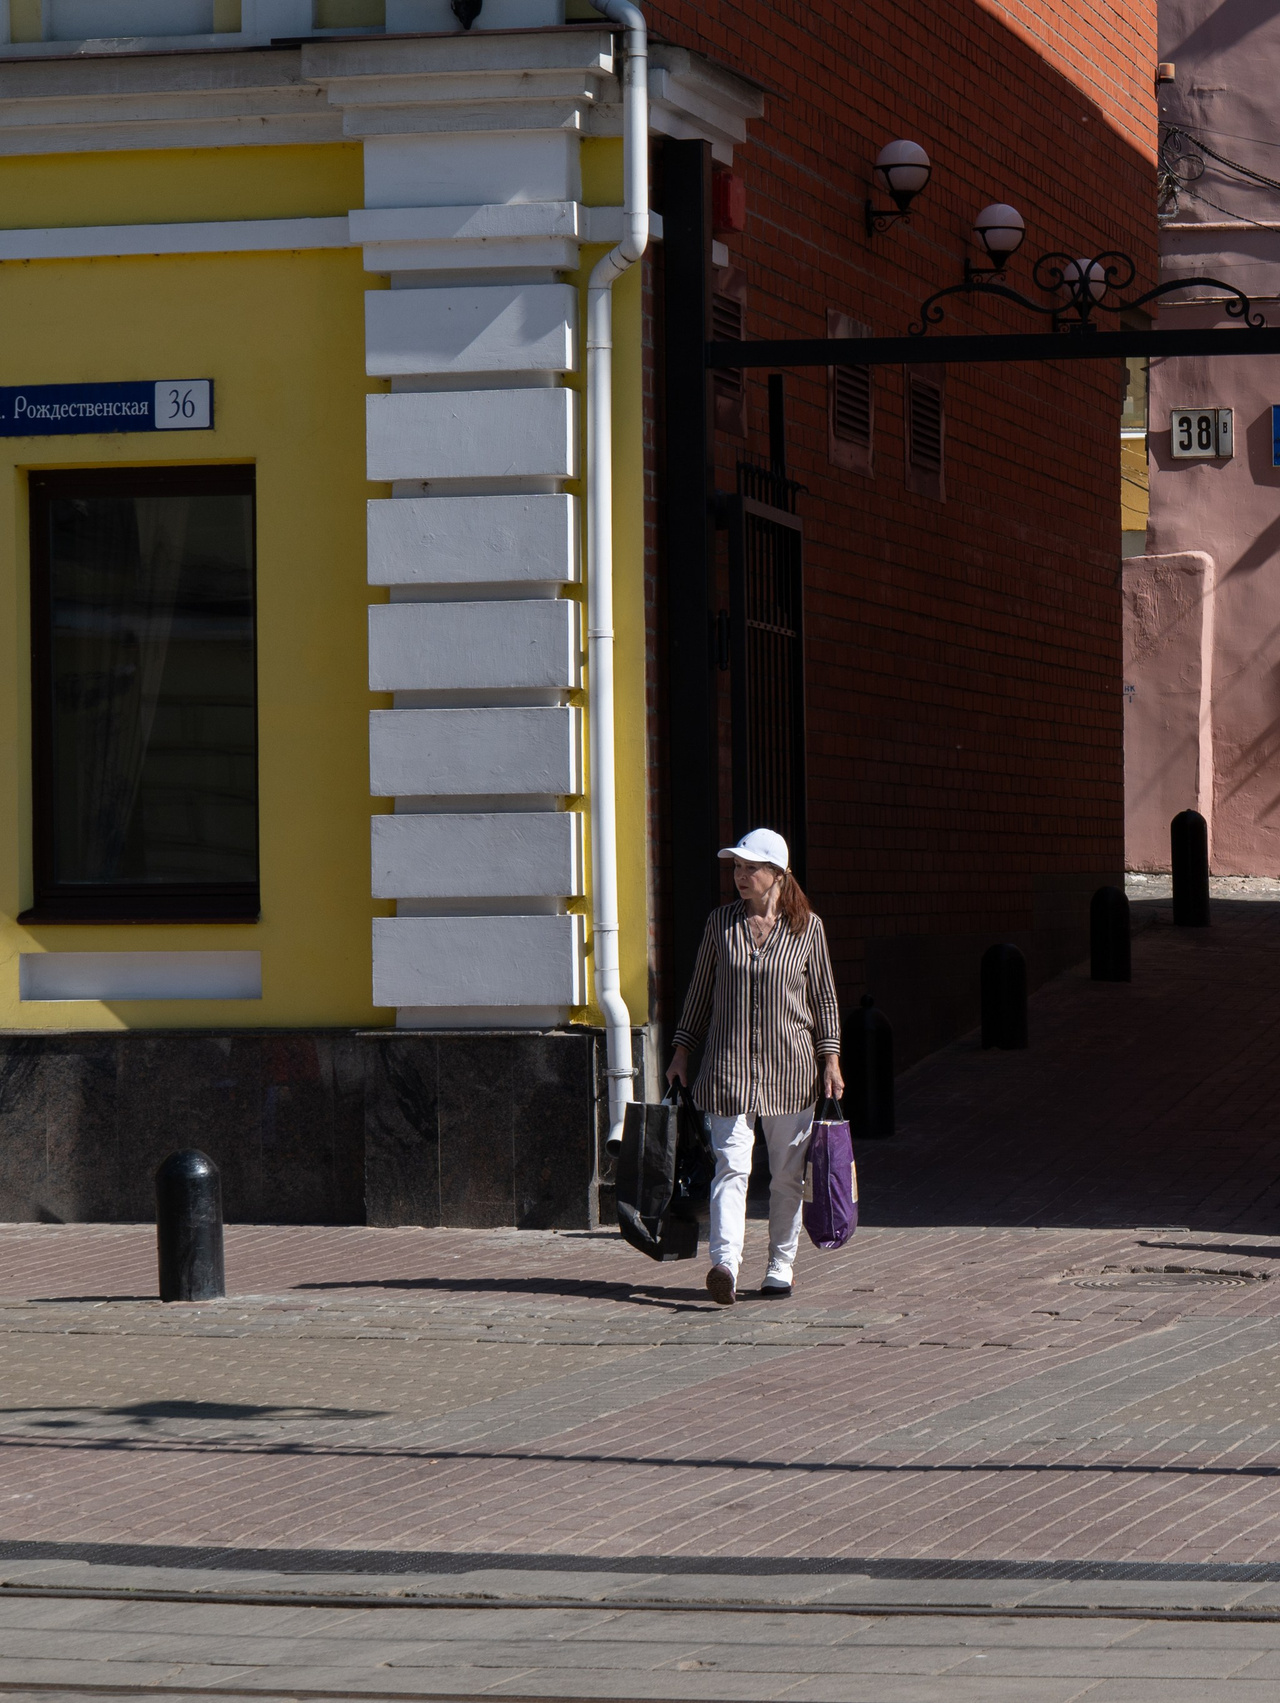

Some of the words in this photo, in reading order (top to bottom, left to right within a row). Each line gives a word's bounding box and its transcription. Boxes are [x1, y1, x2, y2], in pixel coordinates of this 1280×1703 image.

[13, 395, 149, 420] Рождественская
[168, 388, 195, 419] 36
[1178, 415, 1211, 451] 38
